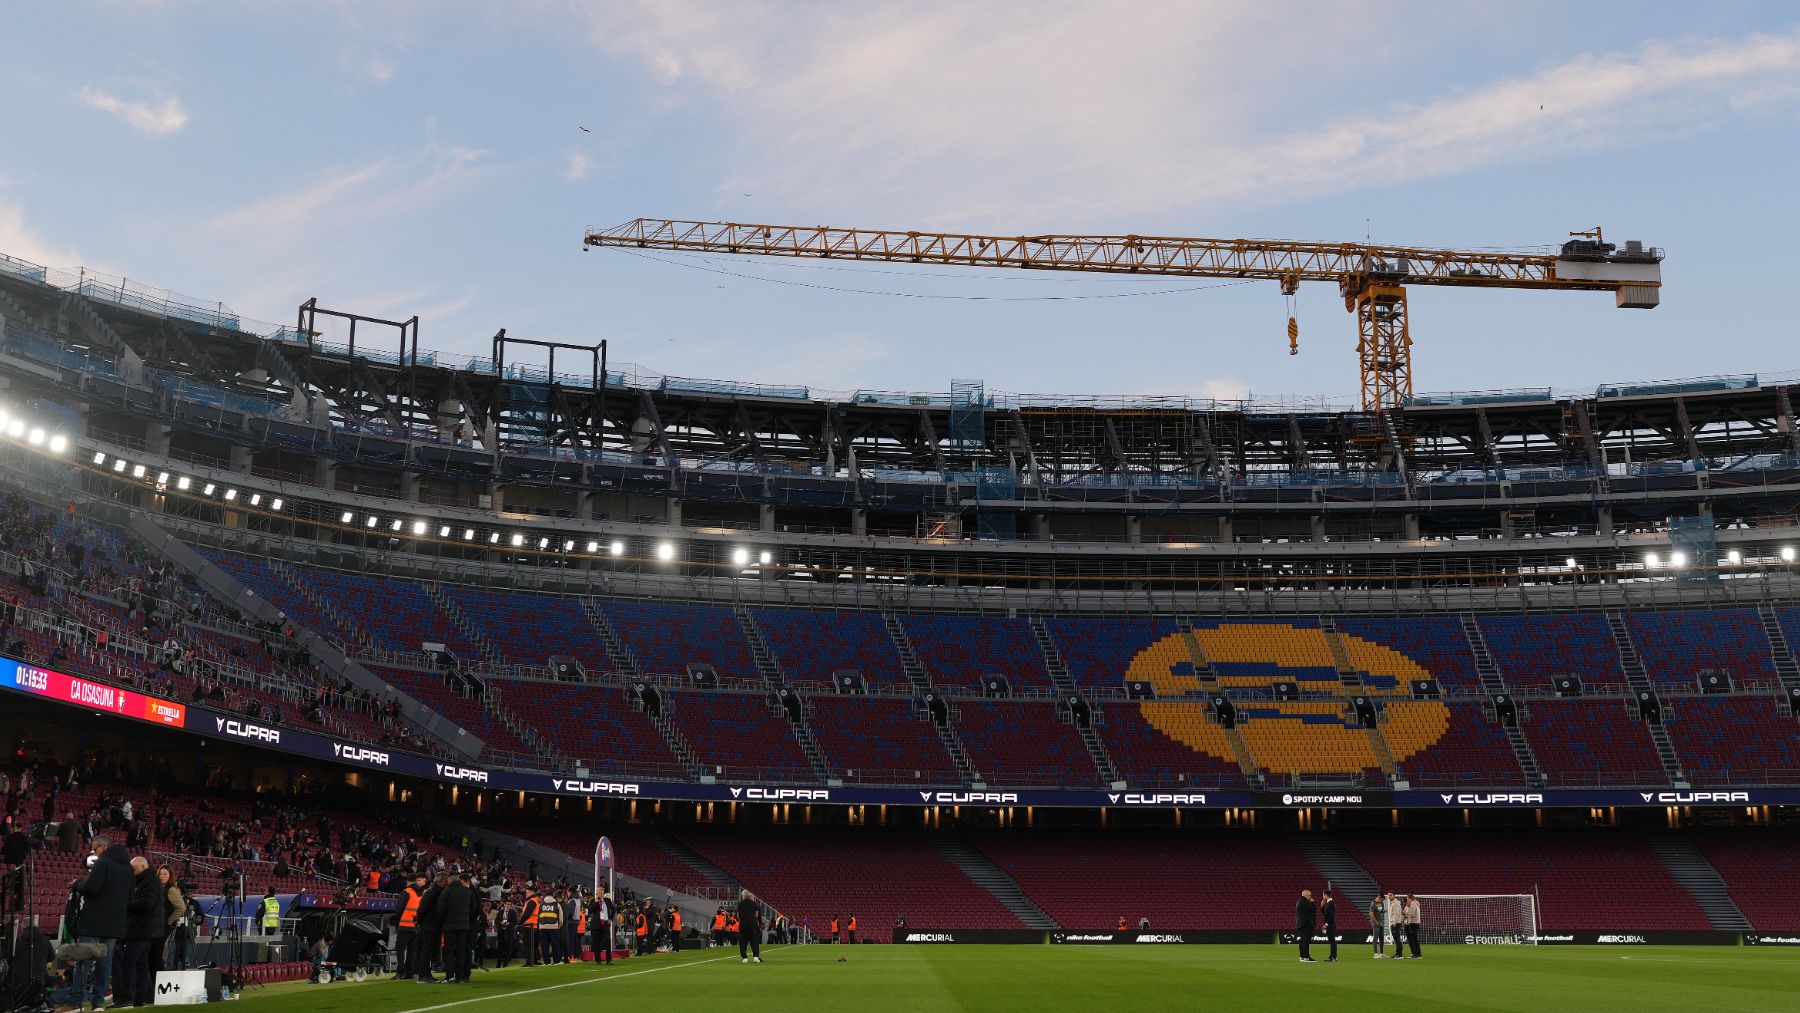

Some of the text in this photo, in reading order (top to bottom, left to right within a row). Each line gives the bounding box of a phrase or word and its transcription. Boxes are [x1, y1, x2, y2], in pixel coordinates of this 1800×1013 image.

[16, 666, 48, 691] 01:15:33
[70, 680, 114, 708] CA OSASUNA
[157, 705, 180, 719] ESTRELLA
[226, 721, 280, 744] CUPRA
[342, 746, 389, 766] CUPRA
[445, 765, 489, 783] CUPRA
[565, 780, 640, 795] CUPRA
[746, 788, 829, 800] CUPRA
[935, 792, 1018, 803] CUPRA
[1124, 793, 1206, 804] CUPRA
[1293, 795, 1362, 803] SPOTIFY CAMP NOU
[1458, 793, 1543, 804] CUPRA
[1658, 792, 1750, 803] CUPRA
[905, 933, 955, 942] MERCURIAL
[1135, 934, 1185, 943] MERCURIAL
[1597, 934, 1647, 943] MERCURIAL
